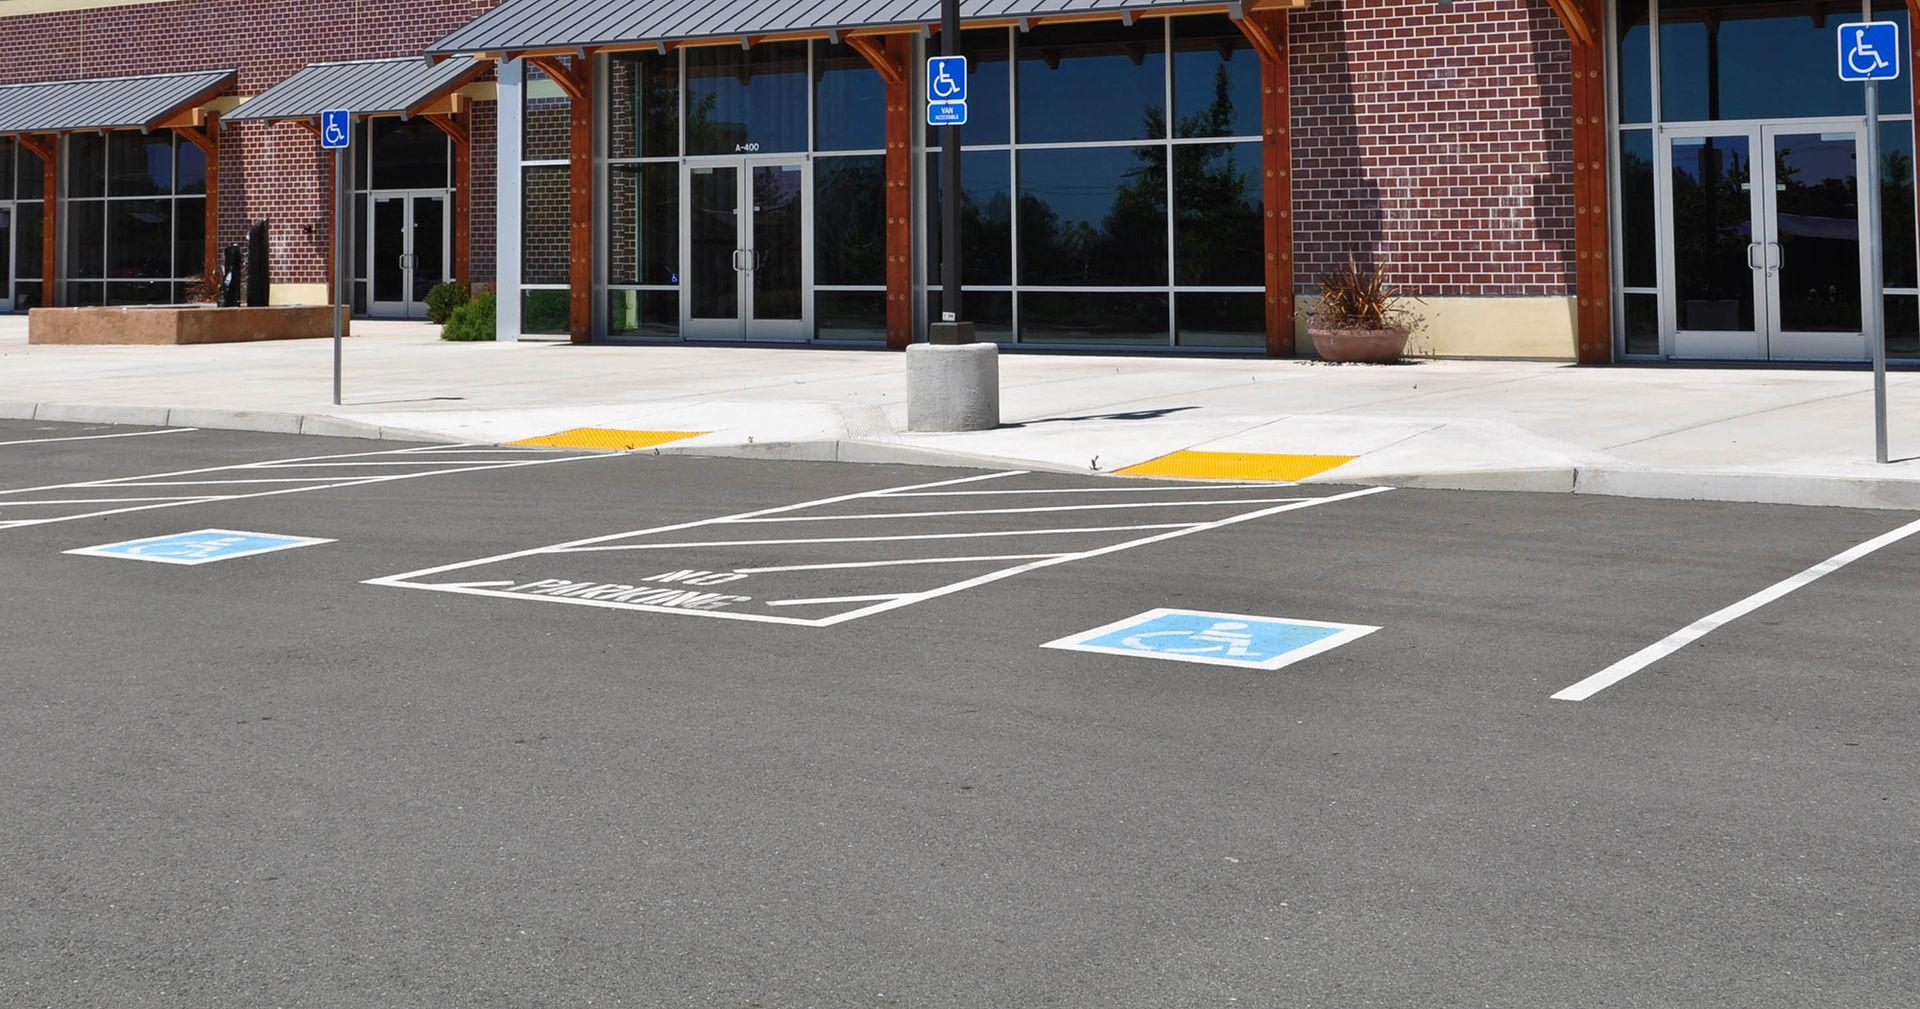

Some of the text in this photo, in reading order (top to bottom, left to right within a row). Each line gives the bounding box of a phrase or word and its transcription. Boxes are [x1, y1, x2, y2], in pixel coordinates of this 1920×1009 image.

[735, 143, 760, 152] A-400
[640, 569, 749, 586] NO
[502, 578, 752, 609] PARKING
